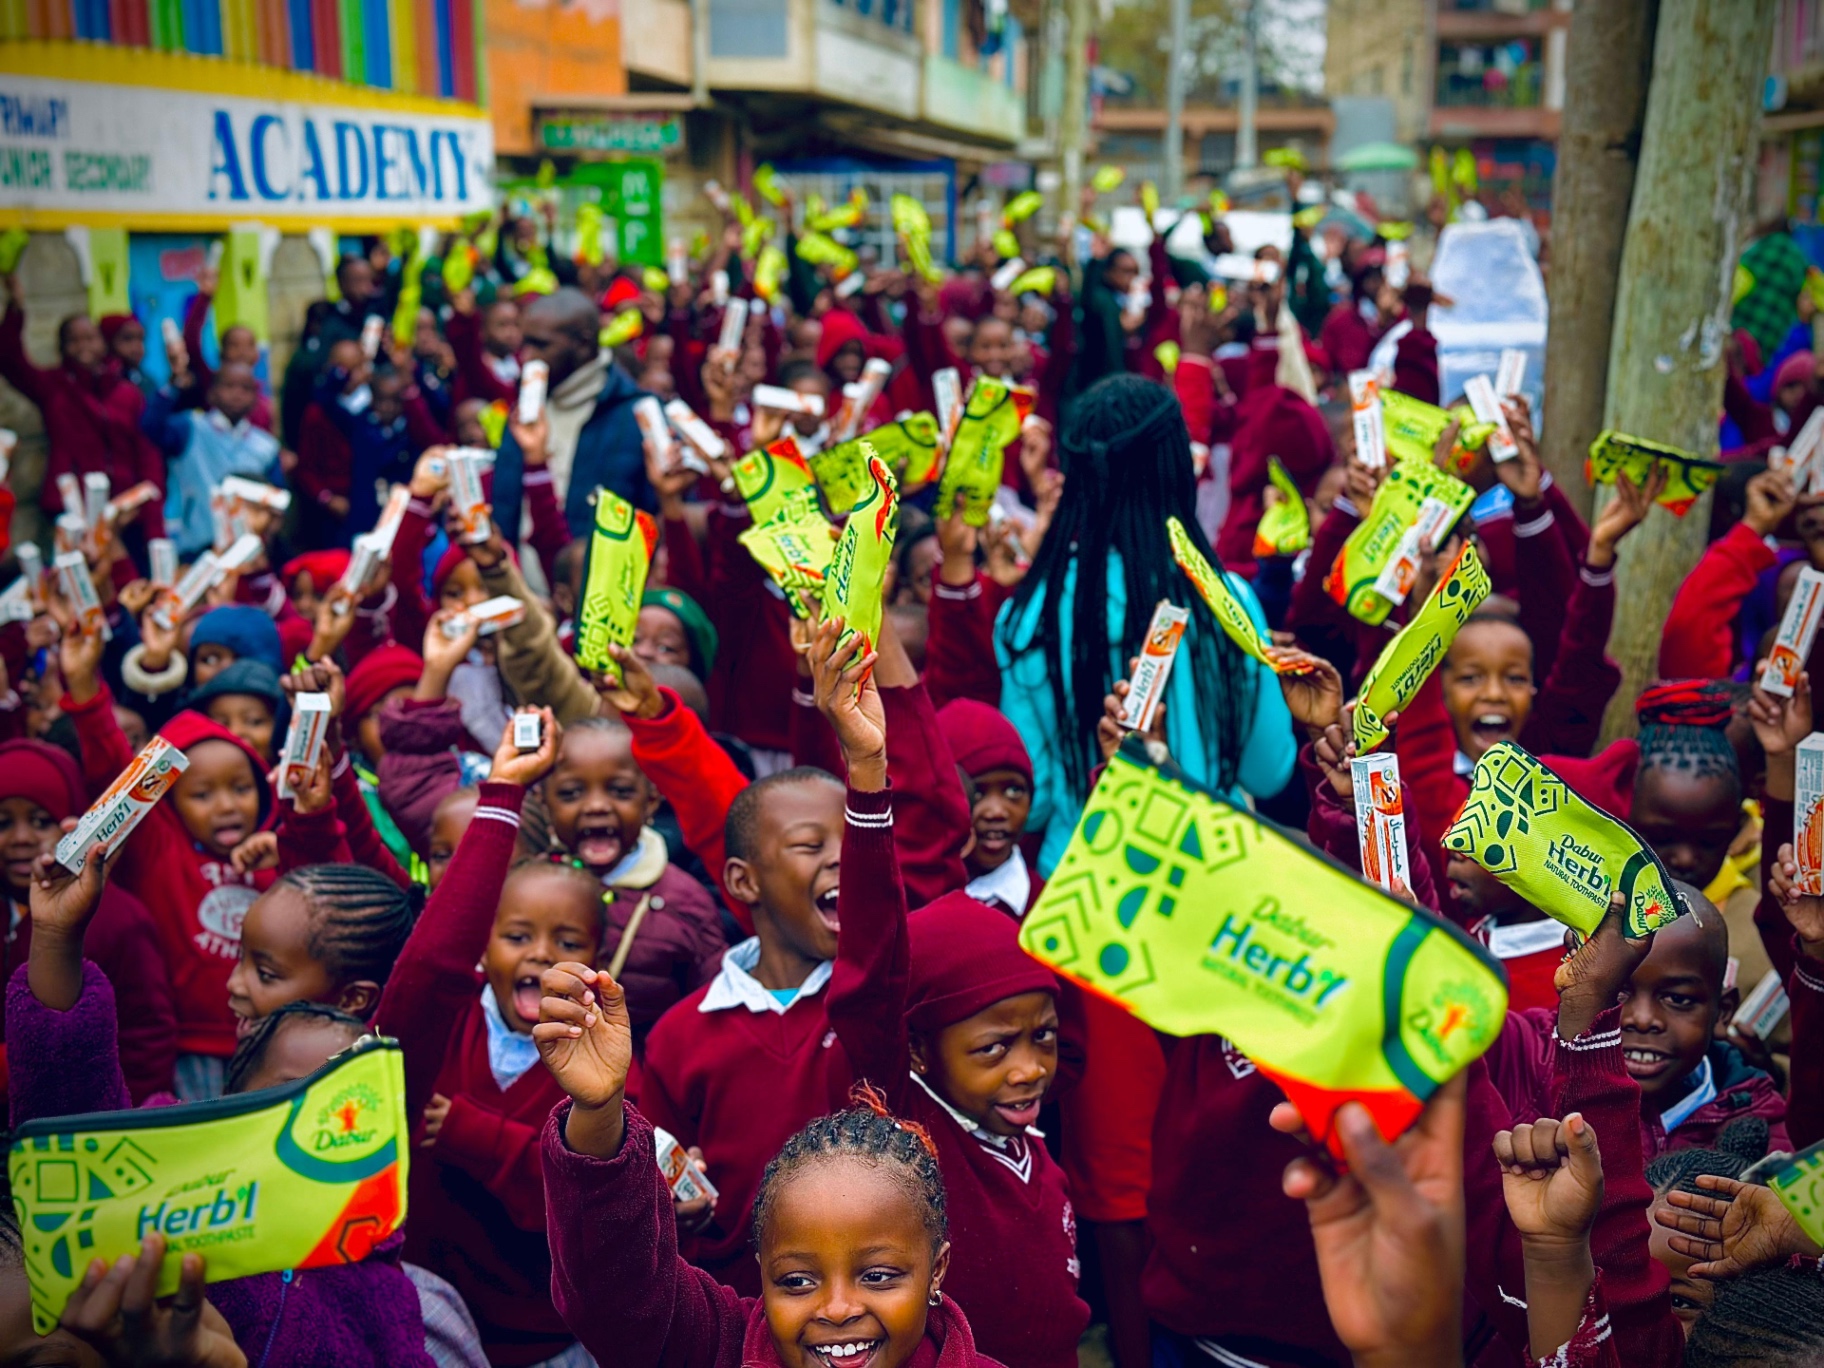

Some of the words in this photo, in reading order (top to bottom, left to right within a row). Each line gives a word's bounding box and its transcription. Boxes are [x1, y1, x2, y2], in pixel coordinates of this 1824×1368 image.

[207, 110, 473, 200] ACADEMY
[1561, 834, 1605, 865] Dabur
[1543, 859, 1570, 884] NATURAL
[1568, 878, 1607, 909] TOOTHPASTE
[312, 1129, 377, 1151] Dabur
